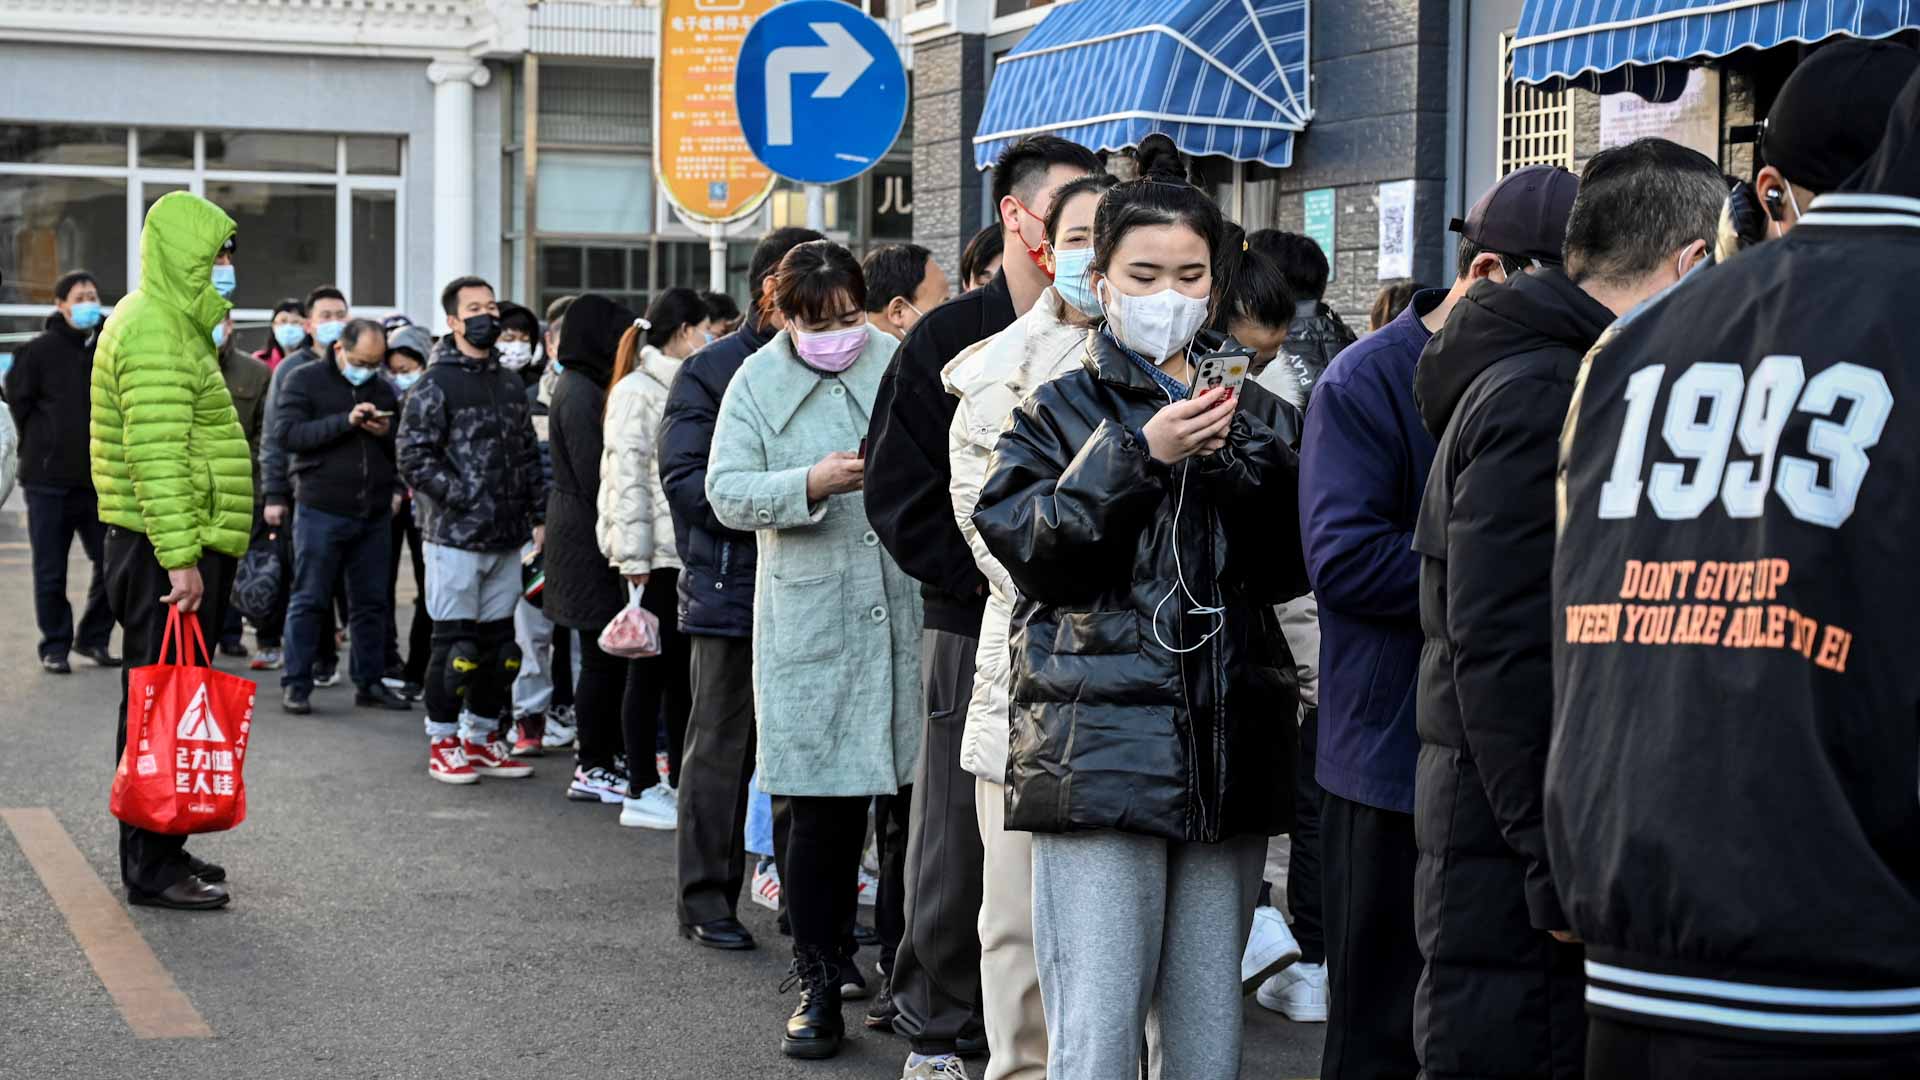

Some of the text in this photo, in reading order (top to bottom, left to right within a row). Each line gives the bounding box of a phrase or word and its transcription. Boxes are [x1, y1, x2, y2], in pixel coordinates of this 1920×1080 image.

[1289, 354, 1312, 386] PLAY
[1598, 355, 1894, 529] 1993
[1695, 560, 1755, 603] GIVE
[1753, 558, 1790, 600] UP
[1622, 603, 1677, 645] YOU
[1670, 604, 1727, 646] ARE
